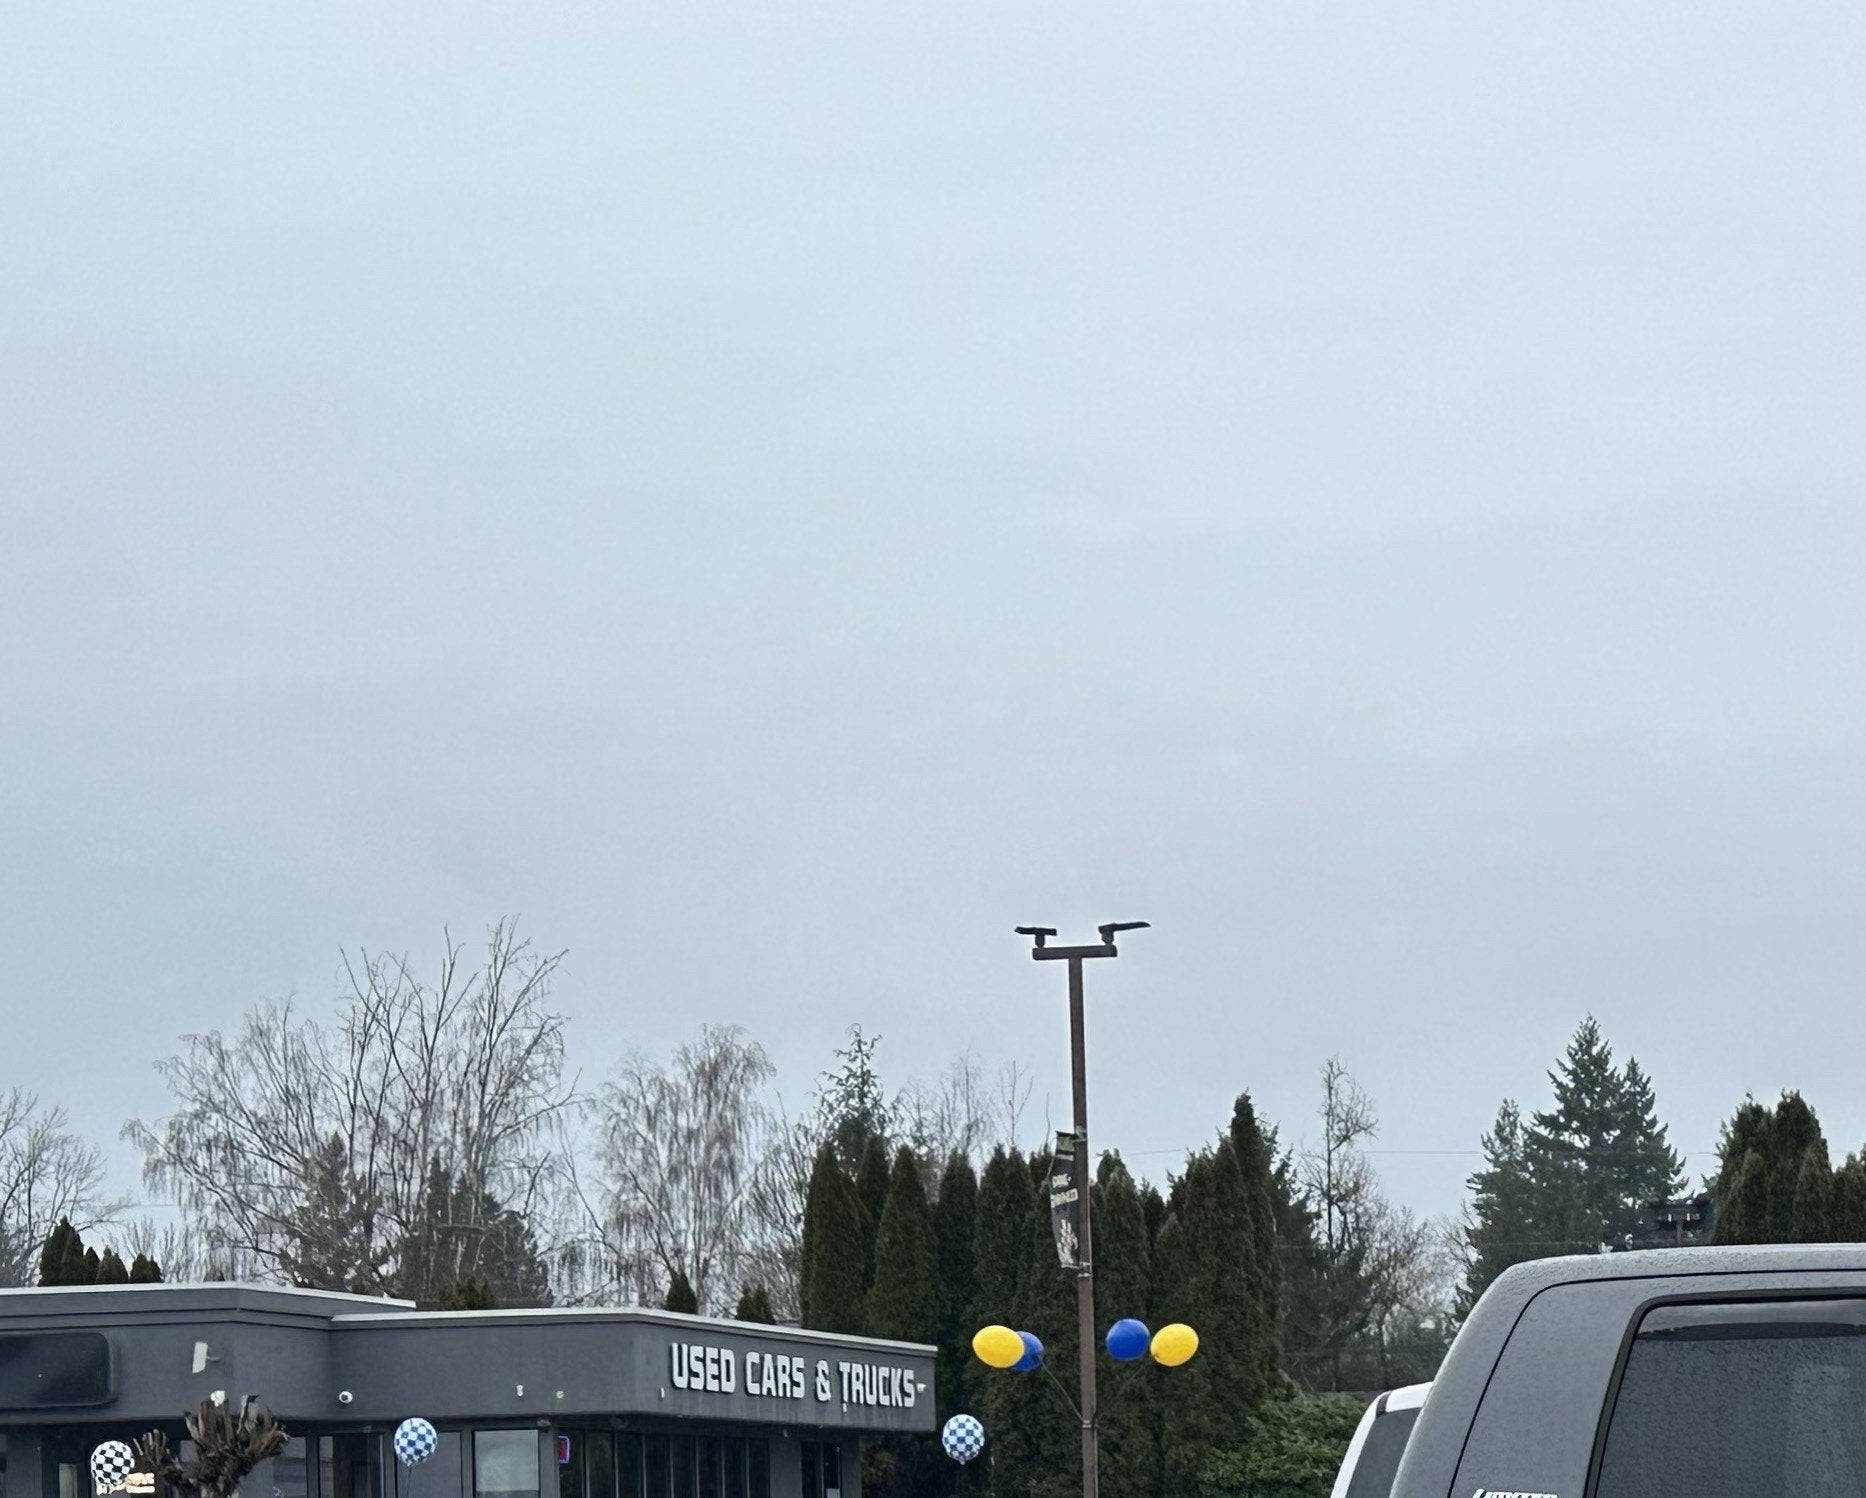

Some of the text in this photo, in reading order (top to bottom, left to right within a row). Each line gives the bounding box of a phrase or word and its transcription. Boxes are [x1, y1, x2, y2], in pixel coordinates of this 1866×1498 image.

[671, 1343, 915, 1408] USED CARS & TRUCKS
